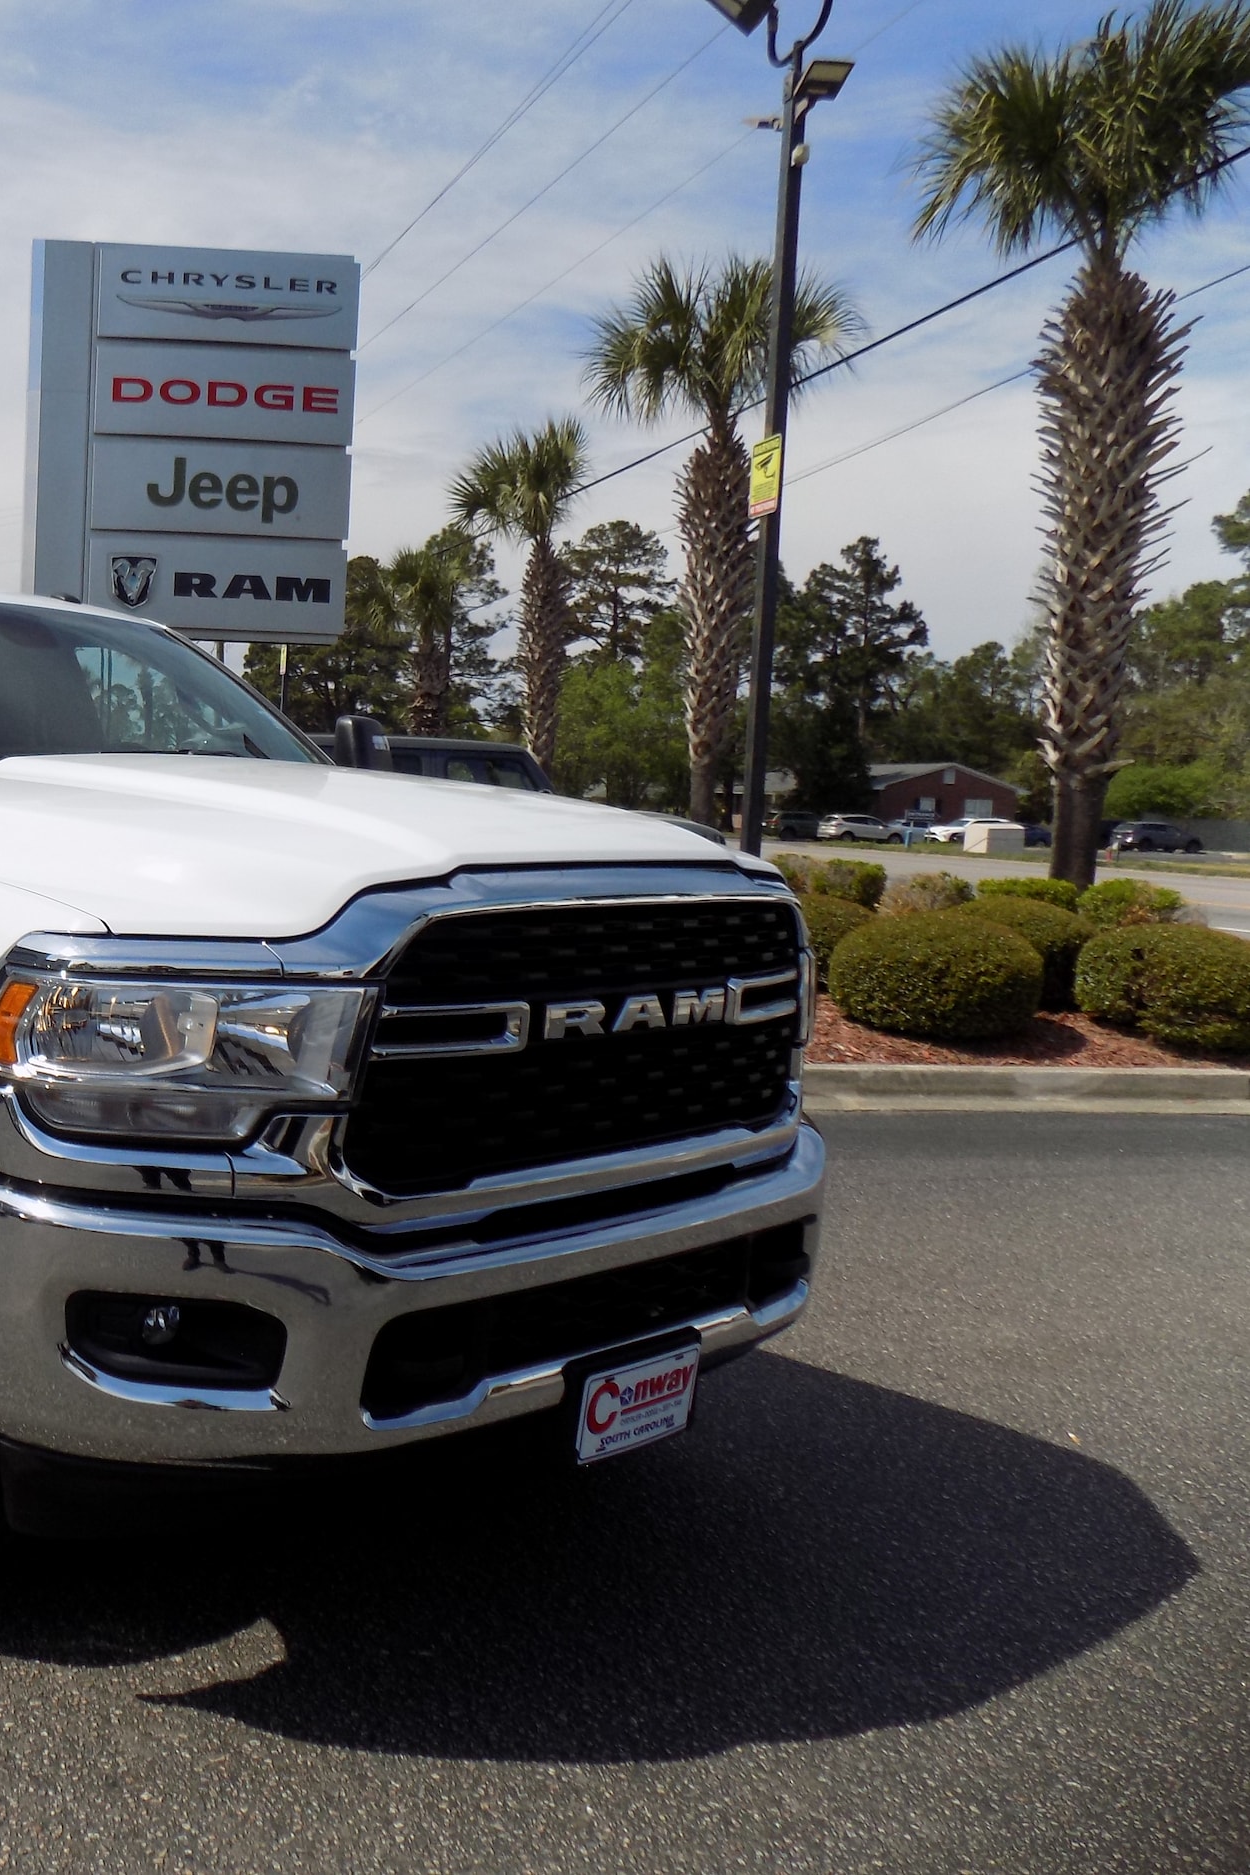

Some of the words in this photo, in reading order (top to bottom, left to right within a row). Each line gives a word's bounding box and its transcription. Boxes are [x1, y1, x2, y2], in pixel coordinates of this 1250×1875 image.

[120, 270, 338, 296] CHRYSLER
[112, 377, 339, 414] DODGE
[146, 457, 299, 523] Jeep
[173, 571, 331, 604] RAM
[544, 987, 725, 1041] RAM
[600, 1430, 631, 1447] SOUTH
[633, 1413, 675, 1437] CAROLINA
